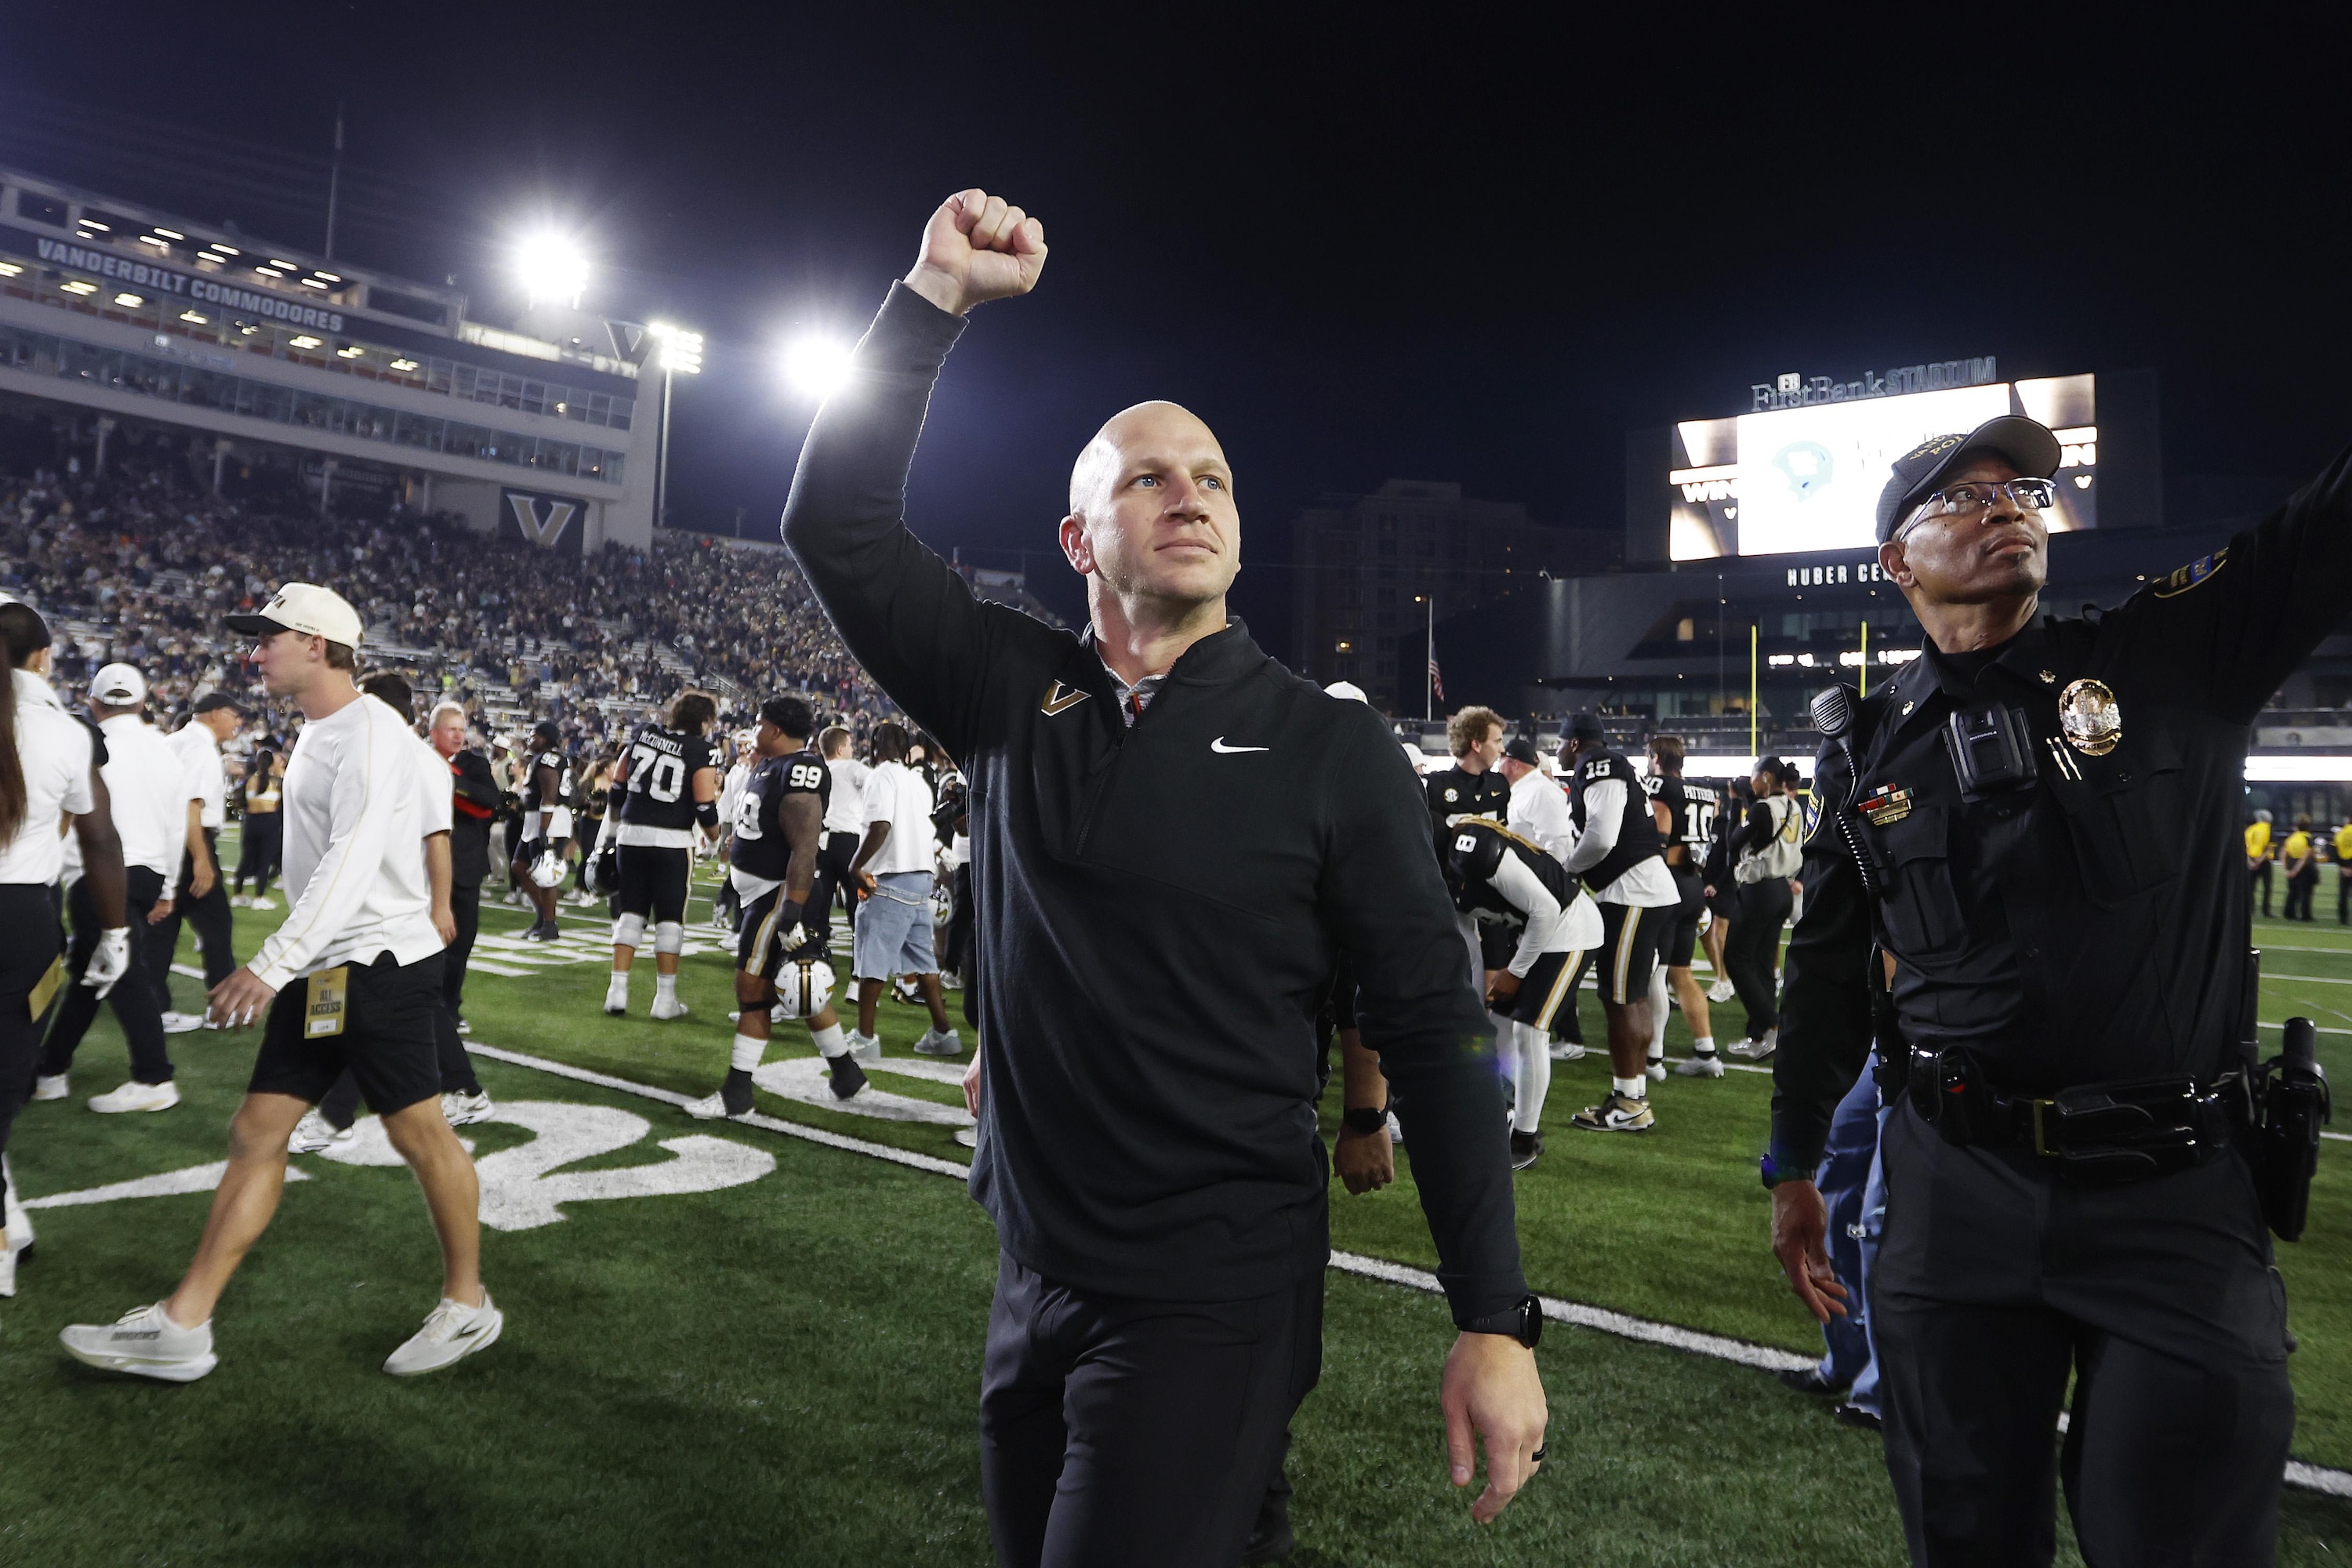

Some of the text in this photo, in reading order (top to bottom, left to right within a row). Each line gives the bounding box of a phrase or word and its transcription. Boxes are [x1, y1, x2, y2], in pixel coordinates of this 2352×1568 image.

[37, 238, 343, 332] VANDERBILT COMMODORES
[1750, 355, 1998, 412] FirstBank STADIUM
[506, 494, 576, 546] V
[1787, 564, 1848, 587] HUBER
[1040, 678, 1092, 717] V
[539, 750, 561, 769] 92
[1585, 758, 1612, 780] 15
[628, 744, 686, 804] 70
[789, 764, 822, 789] 99
[1680, 802, 1715, 842] 10
[1454, 833, 1477, 854] 8
[310, 1001, 341, 1016] ACCESS
[320, 989, 332, 1003] ALL
